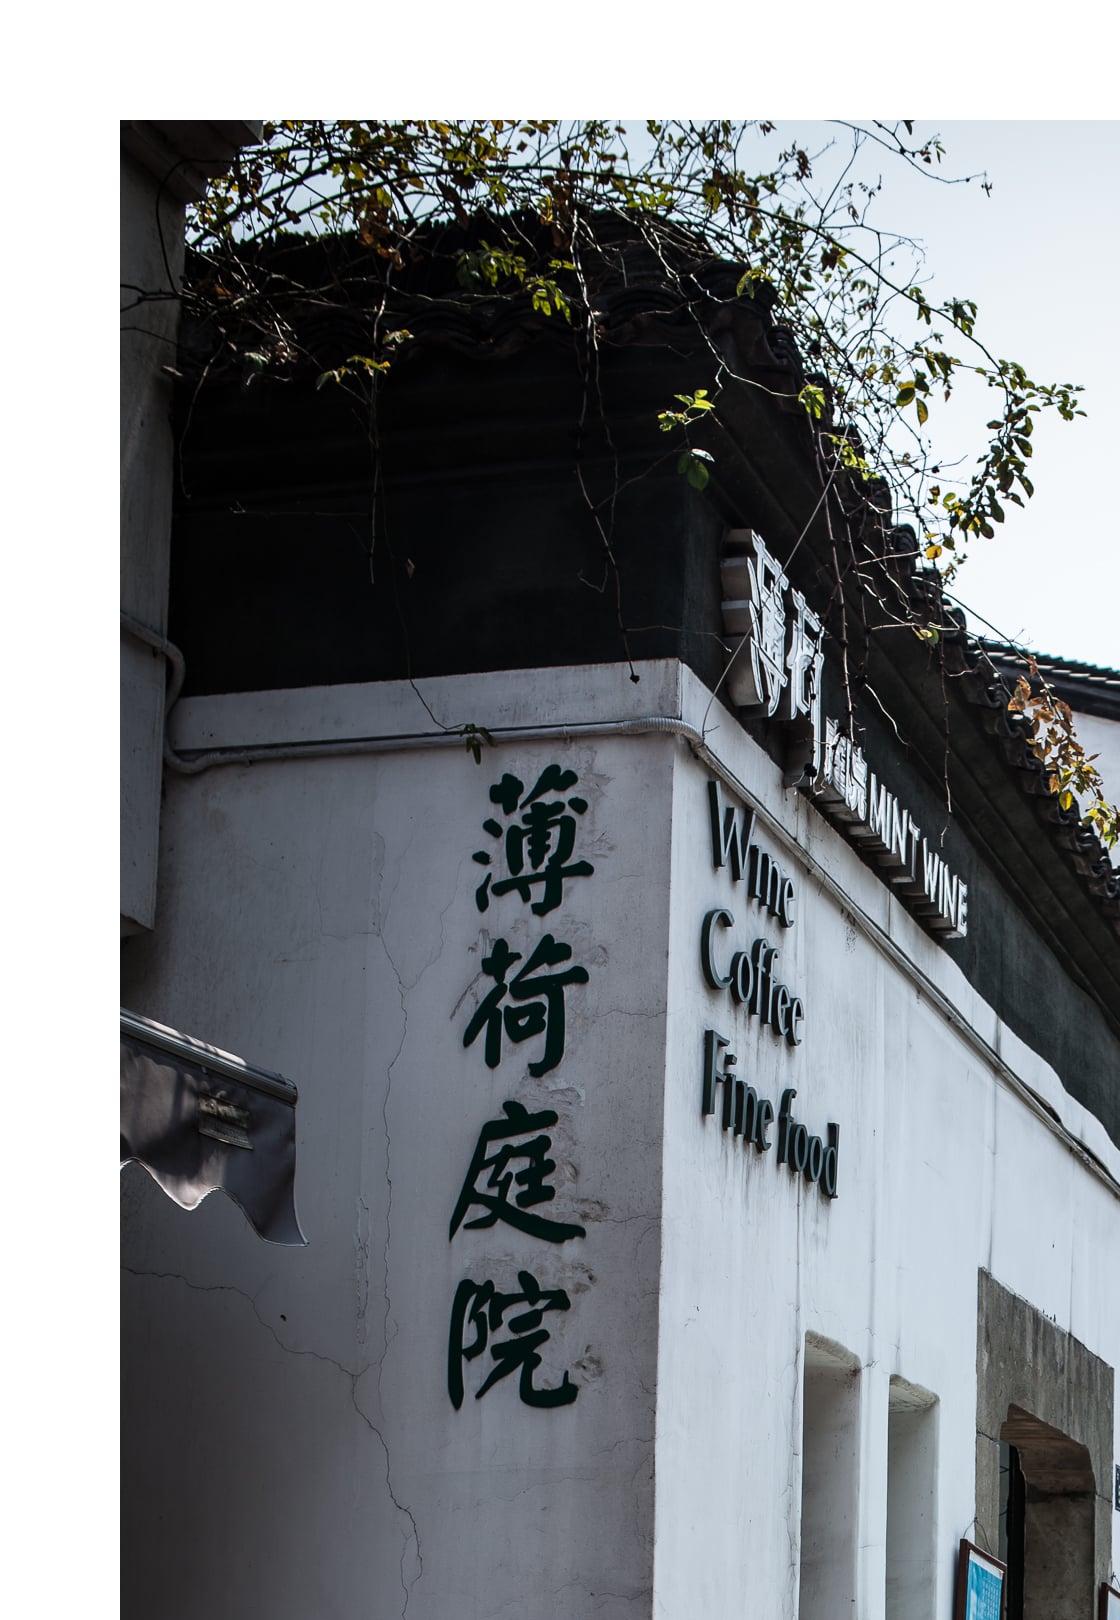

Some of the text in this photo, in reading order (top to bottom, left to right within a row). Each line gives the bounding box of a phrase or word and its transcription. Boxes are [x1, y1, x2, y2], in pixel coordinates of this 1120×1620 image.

[707, 779, 796, 929] Wine
[869, 772, 968, 938] MINT WINE
[701, 908, 805, 1047] Coffee
[446, 762, 595, 1412] 薄荷庭院
[701, 1028, 841, 1200] Fine food
